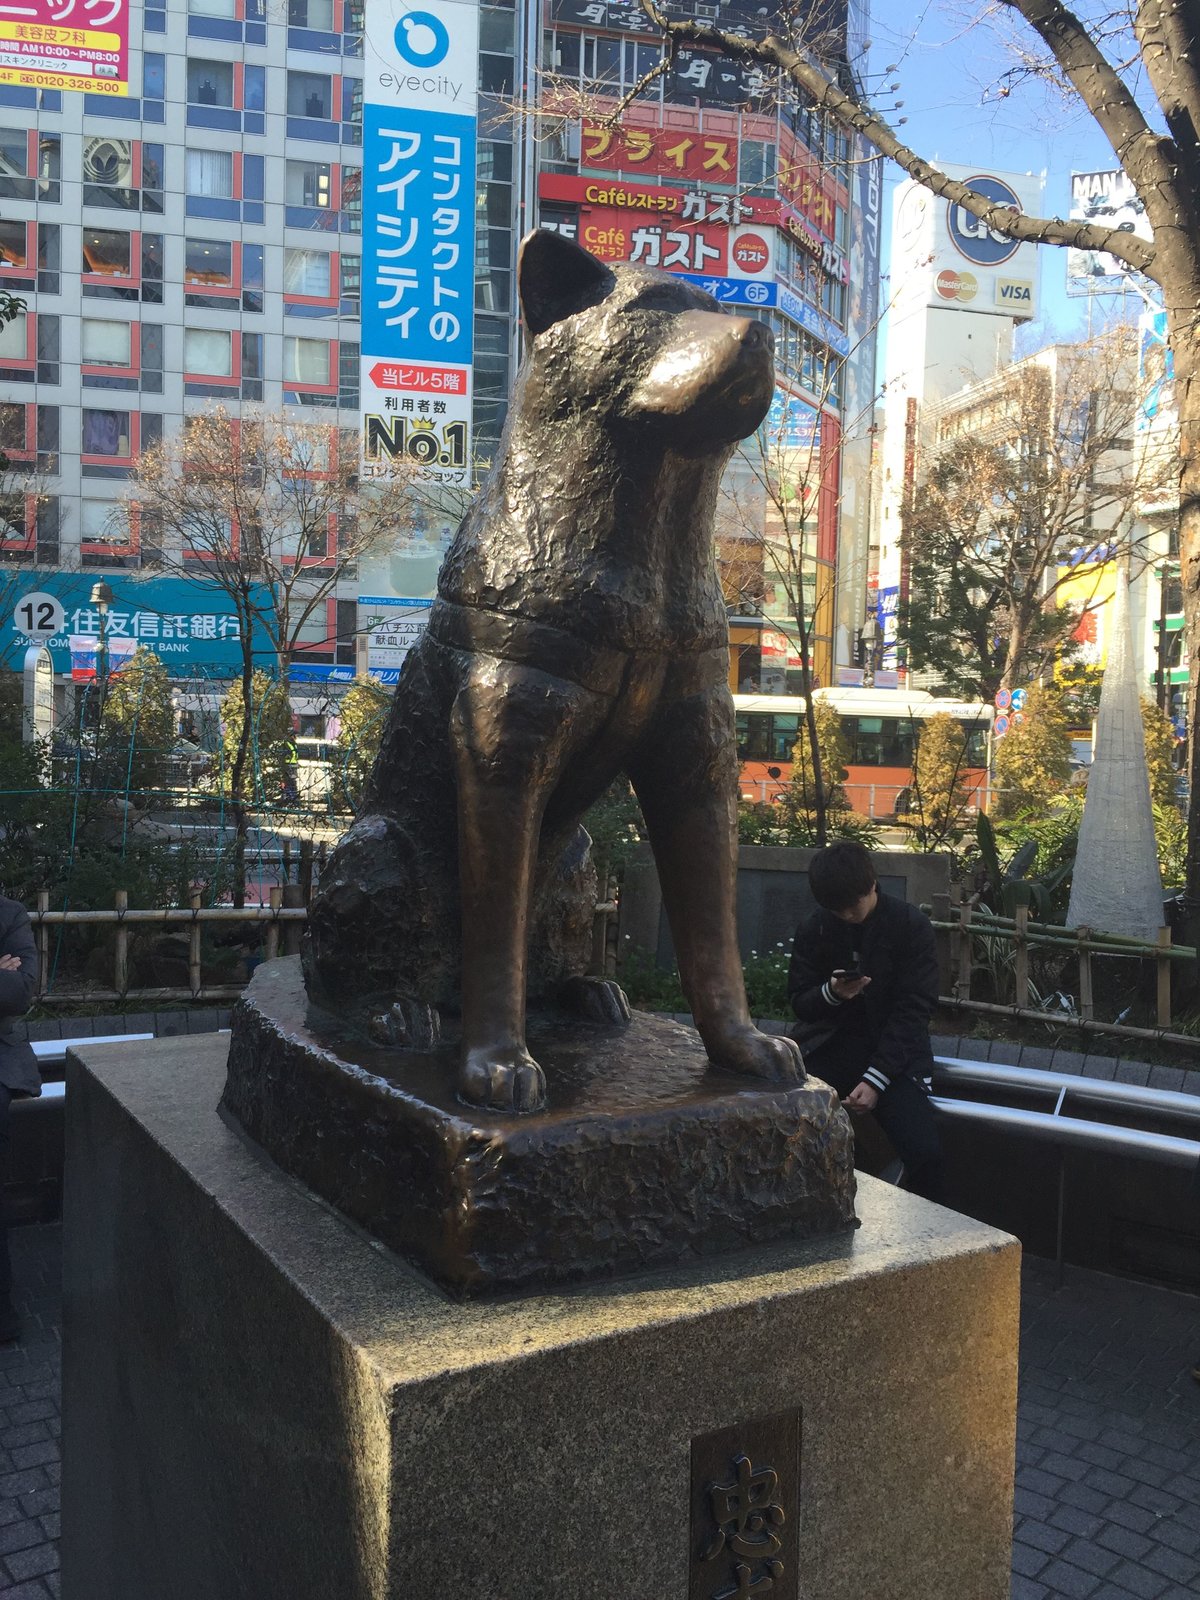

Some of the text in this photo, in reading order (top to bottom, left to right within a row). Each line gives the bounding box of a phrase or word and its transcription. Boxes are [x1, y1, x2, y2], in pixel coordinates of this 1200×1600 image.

[15, 25, 87, 45] 美容皮フ科
[0, 55, 68, 69] スキンクリニック
[677, 50, 693, 61] 9F
[36, 75, 119, 92] 0120-326-500
[379, 73, 463, 102] eyecity
[682, 190, 753, 225] ガスト
[376, 127, 421, 339] アイシティ
[429, 134, 461, 343] コンタクトの
[584, 226, 625, 246] Café
[630, 228, 720, 270] ガスト
[737, 250, 766, 263] ガスト
[749, 286, 767, 301] 6F
[1001, 285, 1031, 301] VISA
[382, 368, 460, 391] 当ビル5階
[385, 396, 447, 414] 利用者数
[365, 413, 467, 468] No.1
[13, 608, 242, 641] 住友信託銀行
[21, 602, 55, 631] 12
[158, 642, 190, 653] BANK
